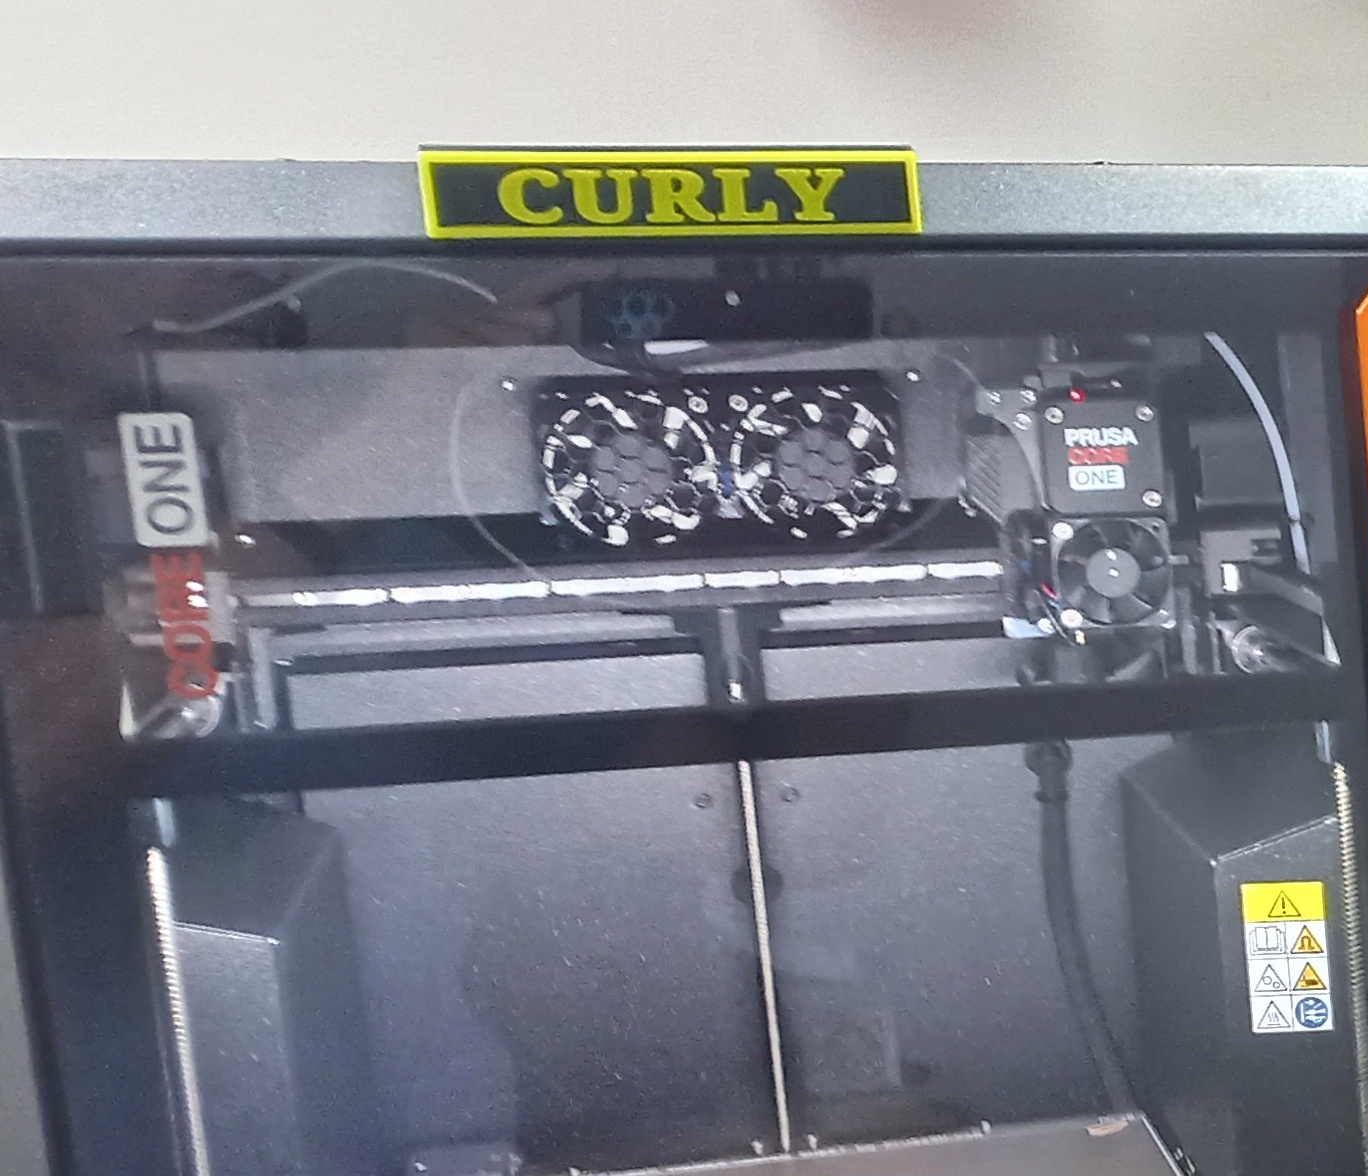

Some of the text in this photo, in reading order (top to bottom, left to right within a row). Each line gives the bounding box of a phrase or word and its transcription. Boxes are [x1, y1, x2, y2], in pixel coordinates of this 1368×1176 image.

[498, 168, 845, 224] CURLY
[1064, 427, 1139, 447] PRUSA
[134, 424, 193, 534] ONE
[1075, 469, 1120, 486] ONE
